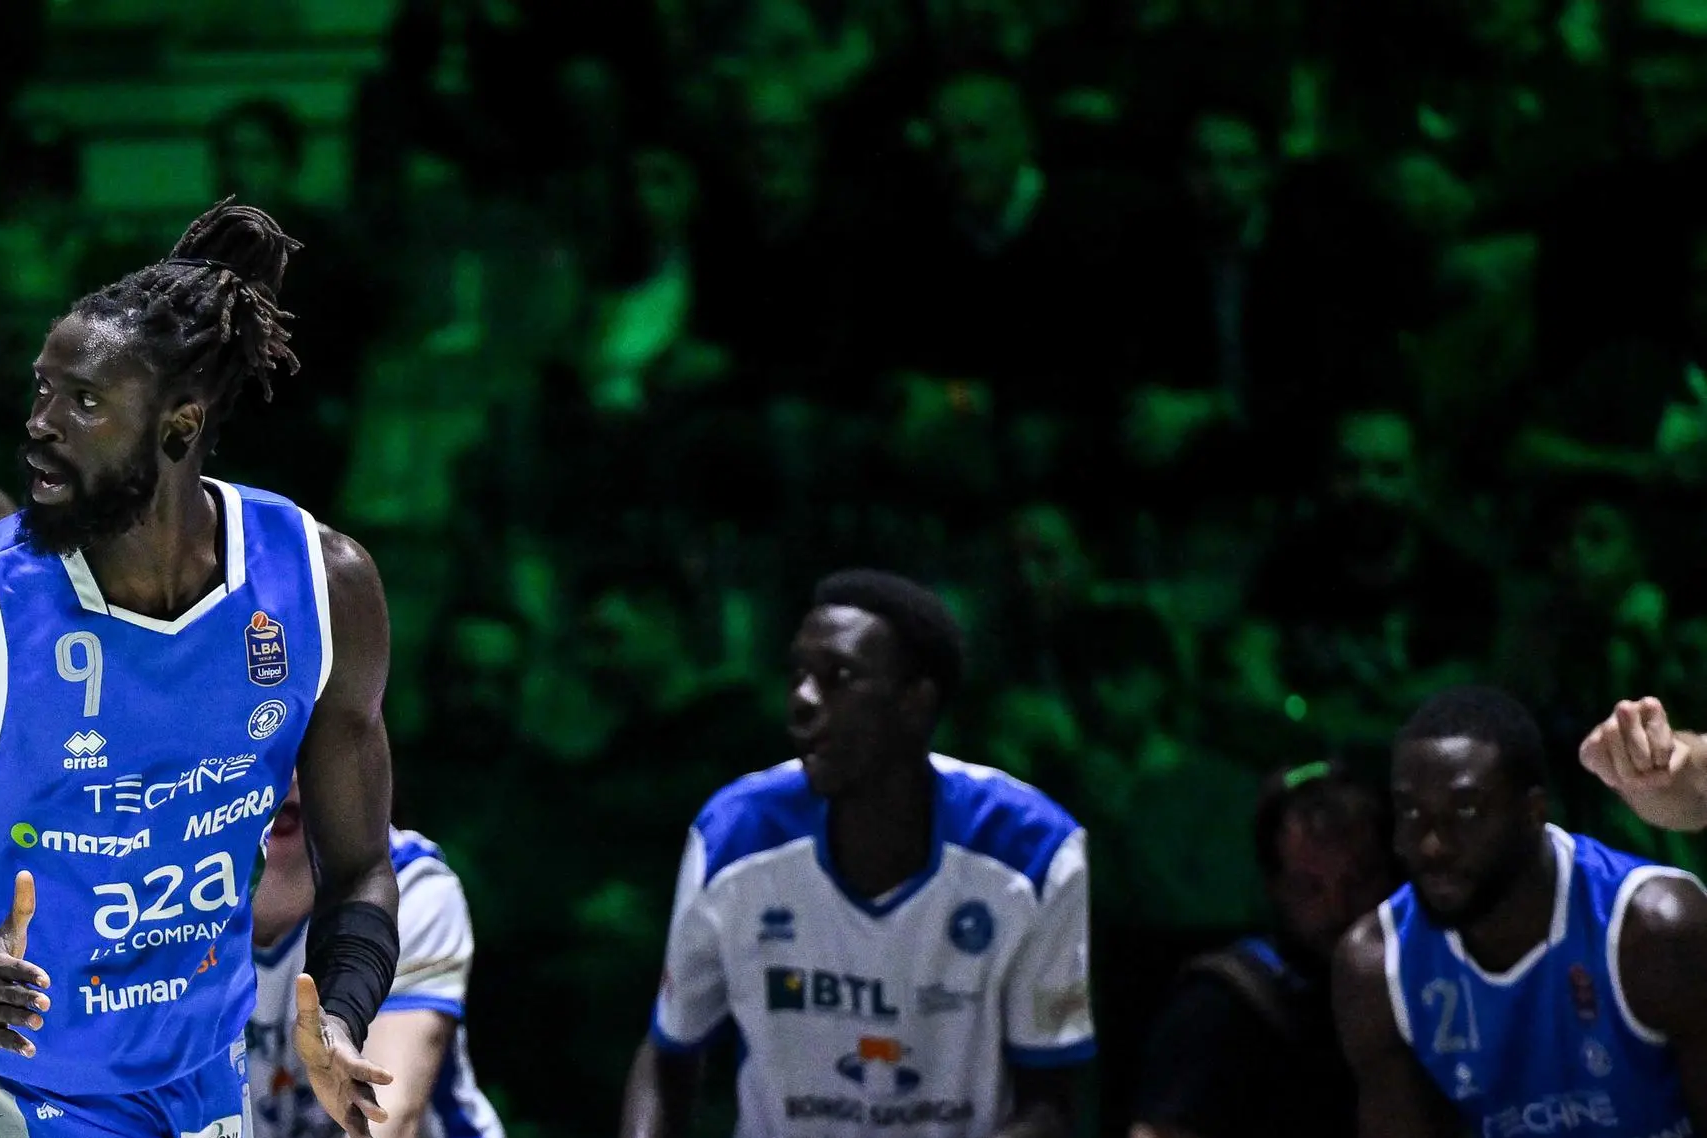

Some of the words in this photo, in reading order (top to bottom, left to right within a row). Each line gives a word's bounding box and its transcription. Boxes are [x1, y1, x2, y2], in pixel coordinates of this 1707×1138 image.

[252, 642, 281, 655] LBA
[55, 631, 103, 717] 9
[258, 666, 281, 678] Unipol
[63, 756, 108, 770] errea
[41, 828, 150, 857] mazza
[93, 851, 239, 939] a2a
[132, 918, 231, 950] COMPAN
[813, 970, 900, 1018] BTL
[1421, 977, 1481, 1053] 21
